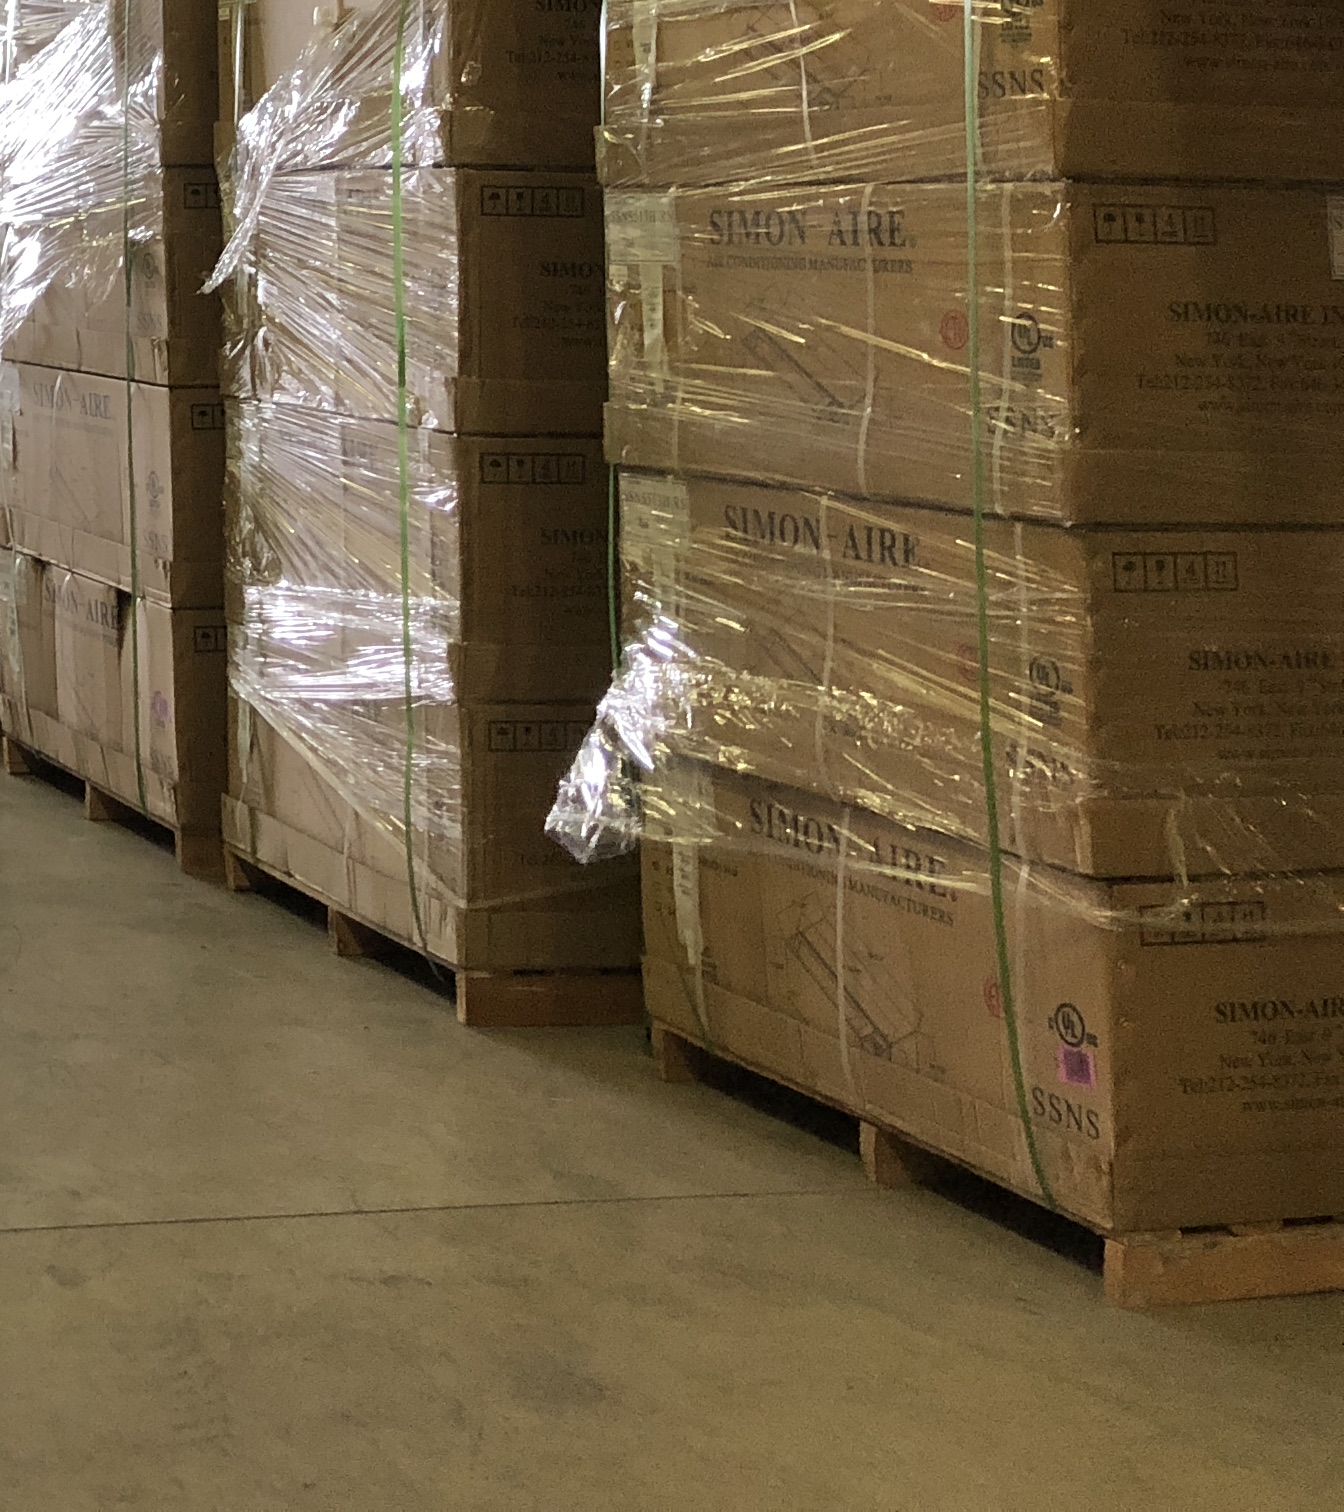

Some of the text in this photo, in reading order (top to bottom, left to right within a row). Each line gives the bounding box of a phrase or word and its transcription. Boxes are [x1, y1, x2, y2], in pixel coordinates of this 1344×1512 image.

[1166, 301, 1312, 326] SIMON-AIRE
[43, 577, 119, 631] SION-AIRE
[843, 879, 955, 927] MANUFACTURERS
[1031, 1085, 1101, 1141] SSNS
